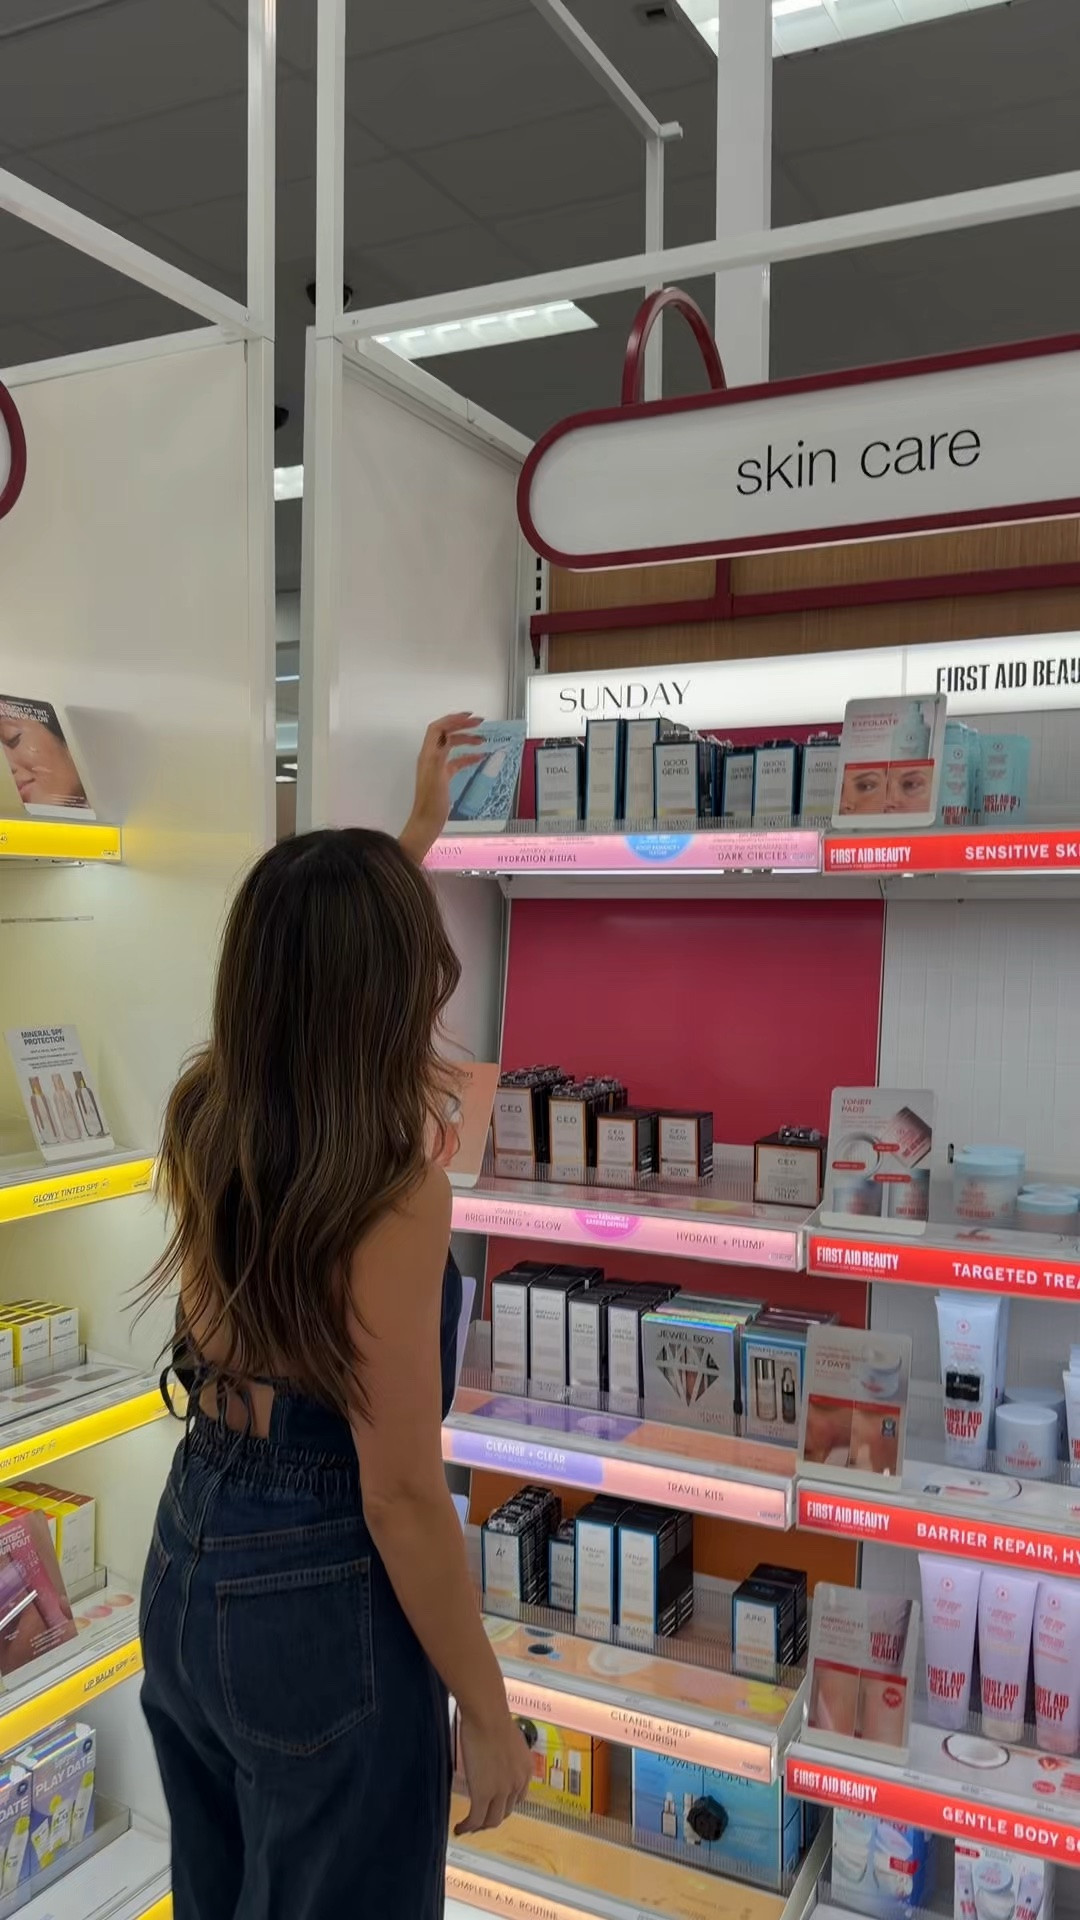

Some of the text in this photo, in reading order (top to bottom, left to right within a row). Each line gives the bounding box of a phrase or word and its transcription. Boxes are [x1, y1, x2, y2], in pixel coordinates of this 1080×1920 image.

[737, 428, 981, 495] skin care
[936, 664, 990, 693] FIRST
[995, 661, 1027, 690] AID
[558, 680, 691, 712] SUNDAY
[545, 766, 570, 775] TIDAL
[663, 758, 688, 767] GOOD
[498, 855, 546, 864] HYDRATION
[718, 852, 744, 861] DARK
[747, 851, 787, 860] CIRCLES
[830, 848, 857, 864] FIRST
[857, 848, 874, 863] AID
[874, 846, 911, 863] BEAUTY
[965, 844, 1049, 860] SENSITIVE
[21, 1028, 63, 1038] MINERAL SPF
[24, 1035, 65, 1046] PROTECTION
[500, 1104, 523, 1113] CEO
[556, 1115, 577, 1124] CEO
[33, 1191, 60, 1204] GLOWY
[61, 1185, 86, 1197] TINTED
[86, 1182, 99, 1191] SPF
[465, 1213, 523, 1227] BRIGHTENING
[534, 1220, 562, 1232] GLOW
[676, 1232, 718, 1245] HYDRATE
[732, 1237, 765, 1250] PLUMP
[817, 1246, 899, 1270] FIRST AID BEAUTY
[952, 1262, 1037, 1284] TARGETED
[658, 1329, 714, 1345] JEWEL BOX
[944, 1406, 982, 1425] FIRST AID
[946, 1421, 978, 1438] BEAUTY
[14, 1450, 30, 1464] TINT
[486, 1441, 525, 1457] CLEANSE
[536, 1450, 566, 1464] CLEAR
[667, 1482, 724, 1501] TRAVEL KITS
[807, 1501, 890, 1530] FIRST AID BEAUTY
[917, 1523, 987, 1548] BARRIER
[994, 1535, 1058, 1564] REPAIR,
[870, 1631, 892, 1648] FIRST
[871, 1644, 900, 1662] BEAUTY
[84, 1679, 94, 1692] LIP
[95, 1666, 115, 1684] BALM
[927, 1664, 966, 1686] FIRST AID
[929, 1682, 961, 1699] BEAUTY
[1003, 1680, 1019, 1698] AID
[508, 1695, 552, 1712] DULLNESS
[983, 1693, 1015, 1711] BEAUTY
[1053, 1693, 1069, 1709] AID
[610, 1711, 654, 1729] CLEANSE
[667, 1727, 690, 1739] PREP
[633, 1728, 678, 1747] NOURISH
[36, 1769, 66, 1797] PLAY
[66, 1750, 95, 1778] DATE
[793, 1768, 878, 1802] FIRST AID BEAUTY
[943, 1806, 1007, 1834] GENTLE
[1014, 1823, 1059, 1848] BODY
[447, 1876, 491, 1898] COMPLETE
[519, 1900, 559, 1920] ROUTINE
